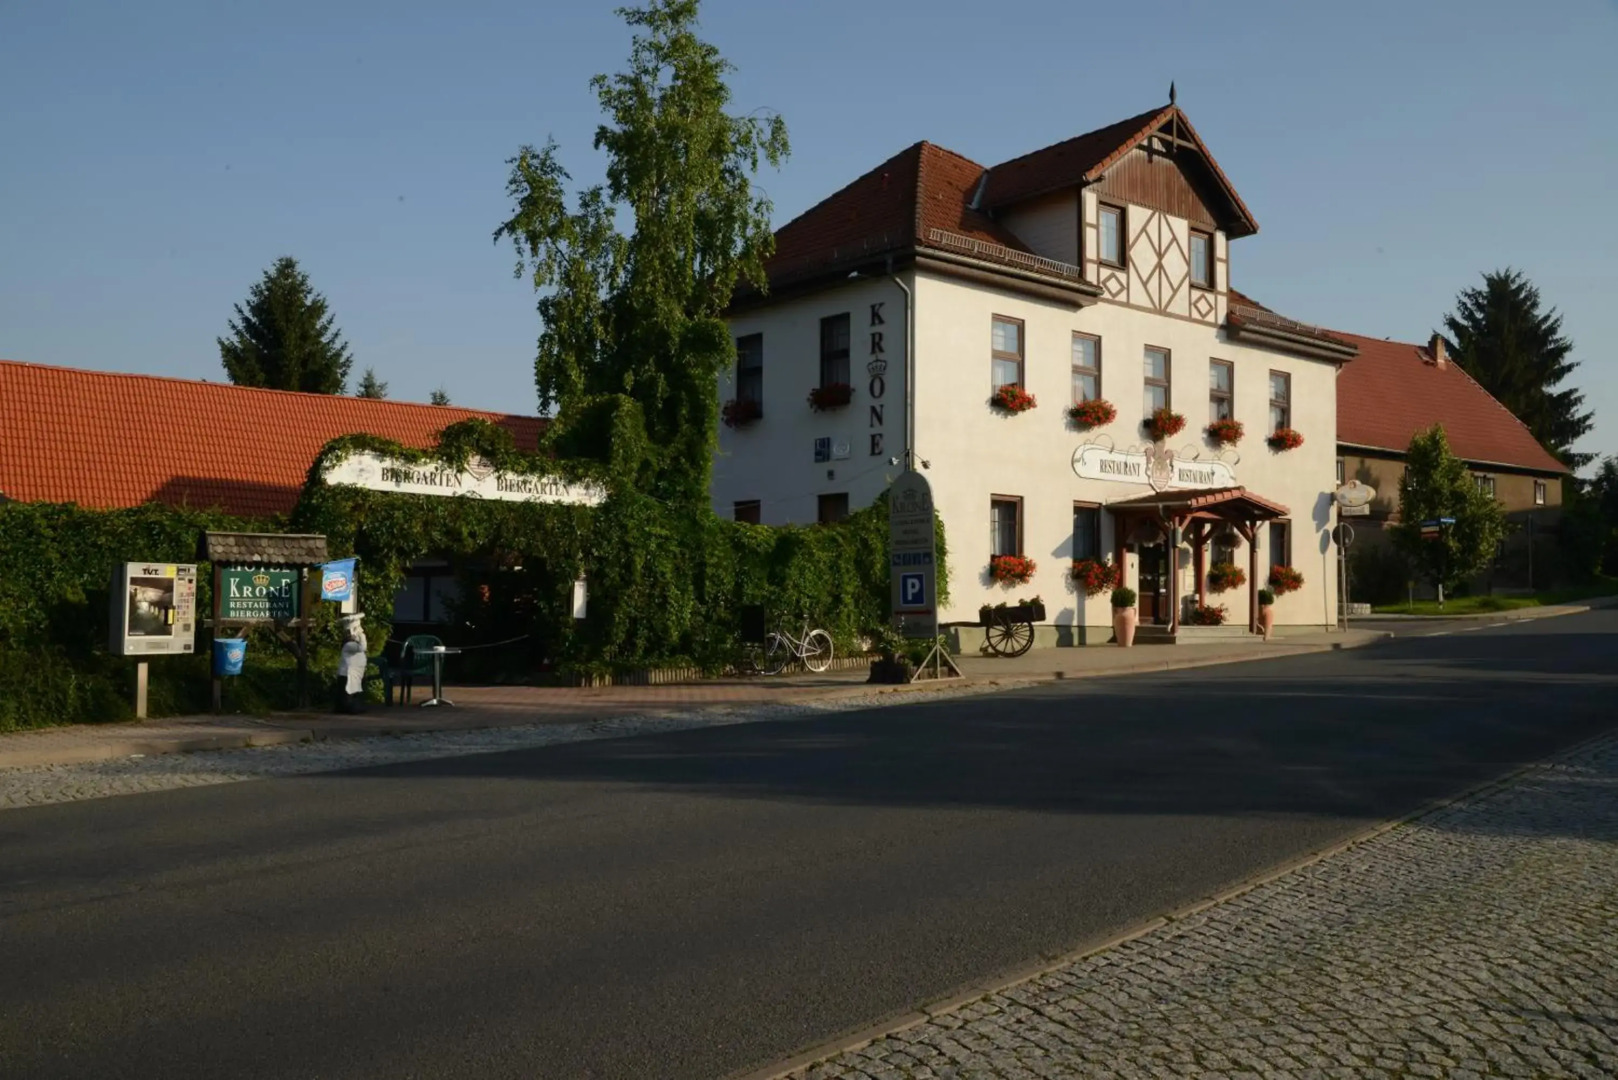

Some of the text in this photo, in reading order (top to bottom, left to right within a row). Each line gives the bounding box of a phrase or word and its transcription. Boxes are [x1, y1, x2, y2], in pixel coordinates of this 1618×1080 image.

[869, 302, 886, 456] KRONE
[381, 466, 463, 488] BIERGARTEN
[1099, 459, 1141, 478] RESTAURANT
[1178, 468, 1215, 485] RESTAURANT
[496, 476, 570, 497] BIERGARTEN
[229, 577, 291, 598] KRONE
[906, 578, 921, 601] P
[229, 601, 290, 609] RESTAURANT
[229, 610, 290, 618] BIERGARTEN
